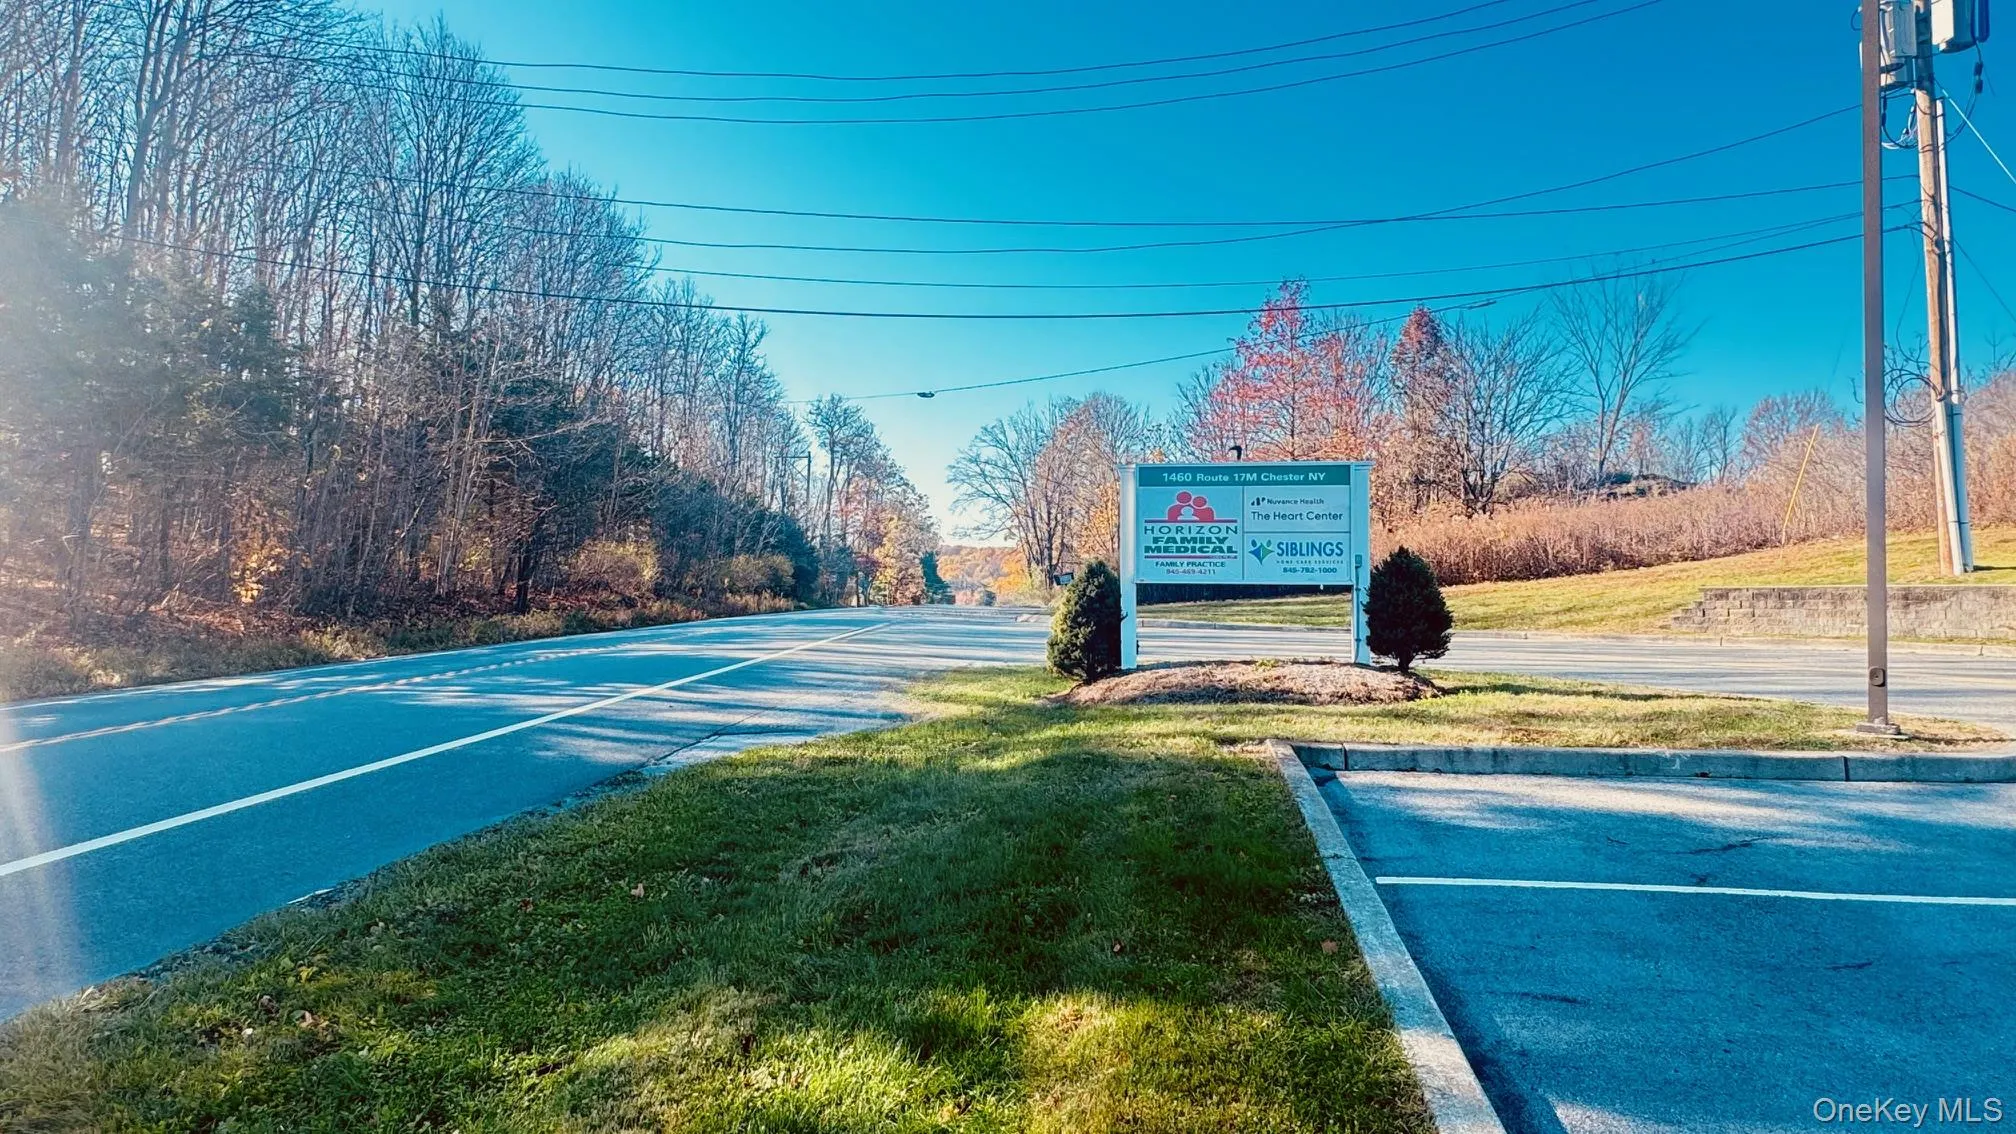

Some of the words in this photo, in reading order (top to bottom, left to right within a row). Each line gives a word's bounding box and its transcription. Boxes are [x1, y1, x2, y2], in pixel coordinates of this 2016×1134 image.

[1162, 473, 1192, 482] 1460
[1197, 474, 1229, 482] Route
[1233, 473, 1257, 481] 17M
[1261, 472, 1305, 481] Chester
[1309, 472, 1326, 480] NY
[1251, 511, 1270, 520] The
[1273, 512, 1304, 520] Heart
[1306, 512, 1344, 520] Center
[1144, 526, 1238, 534] HORIZON
[1152, 536, 1228, 544] FAMILY
[1144, 546, 1238, 554] MEDICAL
[1276, 542, 1344, 557] SIBLINGS
